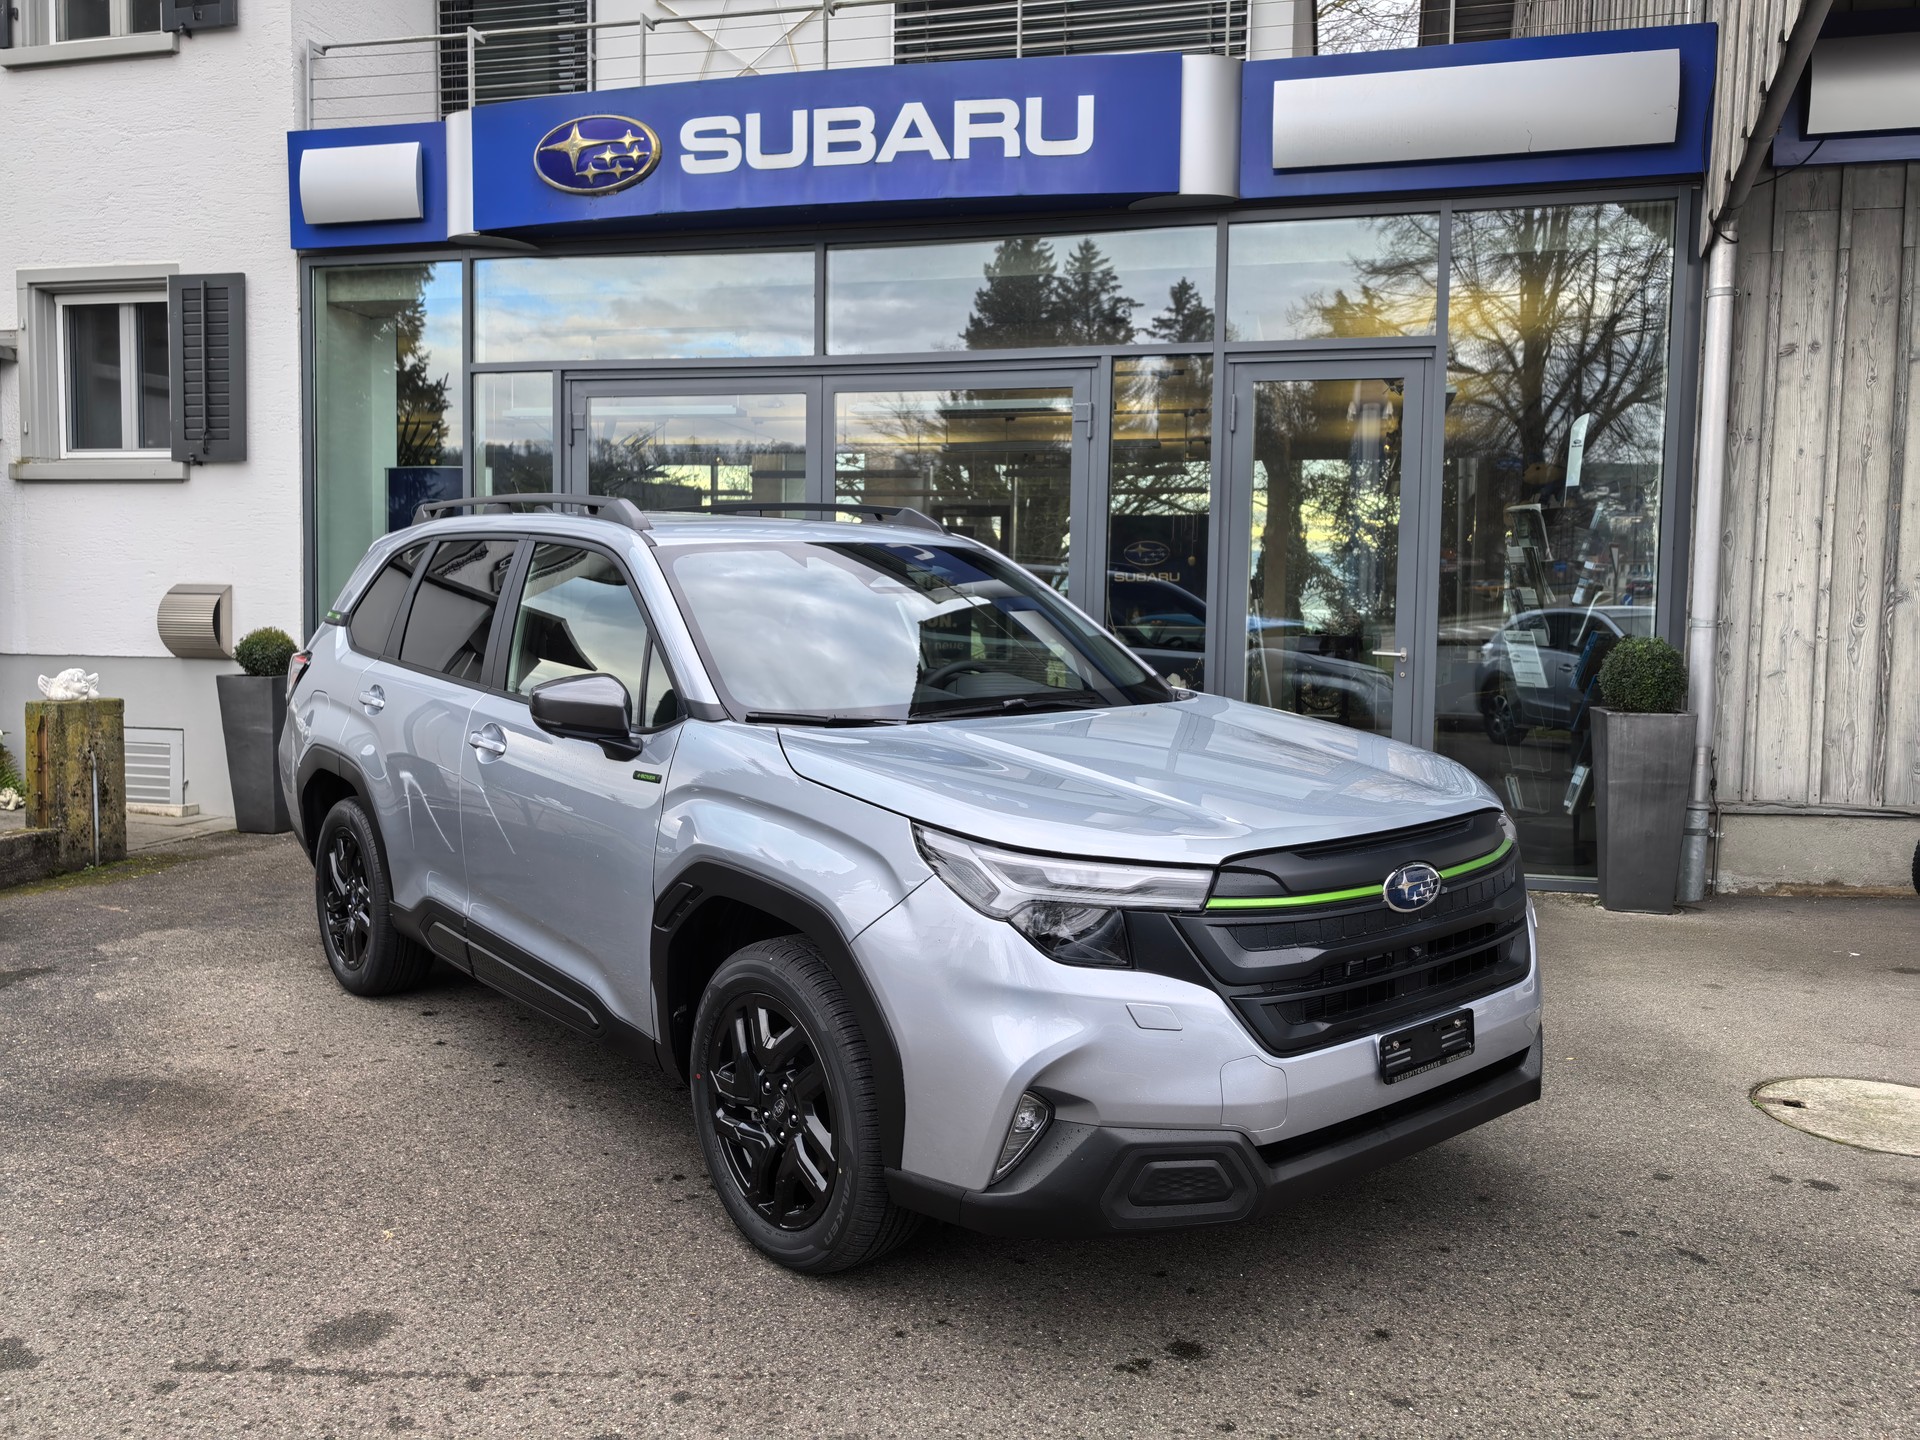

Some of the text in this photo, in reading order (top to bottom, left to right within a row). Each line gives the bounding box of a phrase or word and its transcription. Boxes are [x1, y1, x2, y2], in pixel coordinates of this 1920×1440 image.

[680, 95, 1095, 175] SUBARU
[1114, 572, 1180, 582] SUBARU
[823, 1166, 852, 1247] FALKEN
